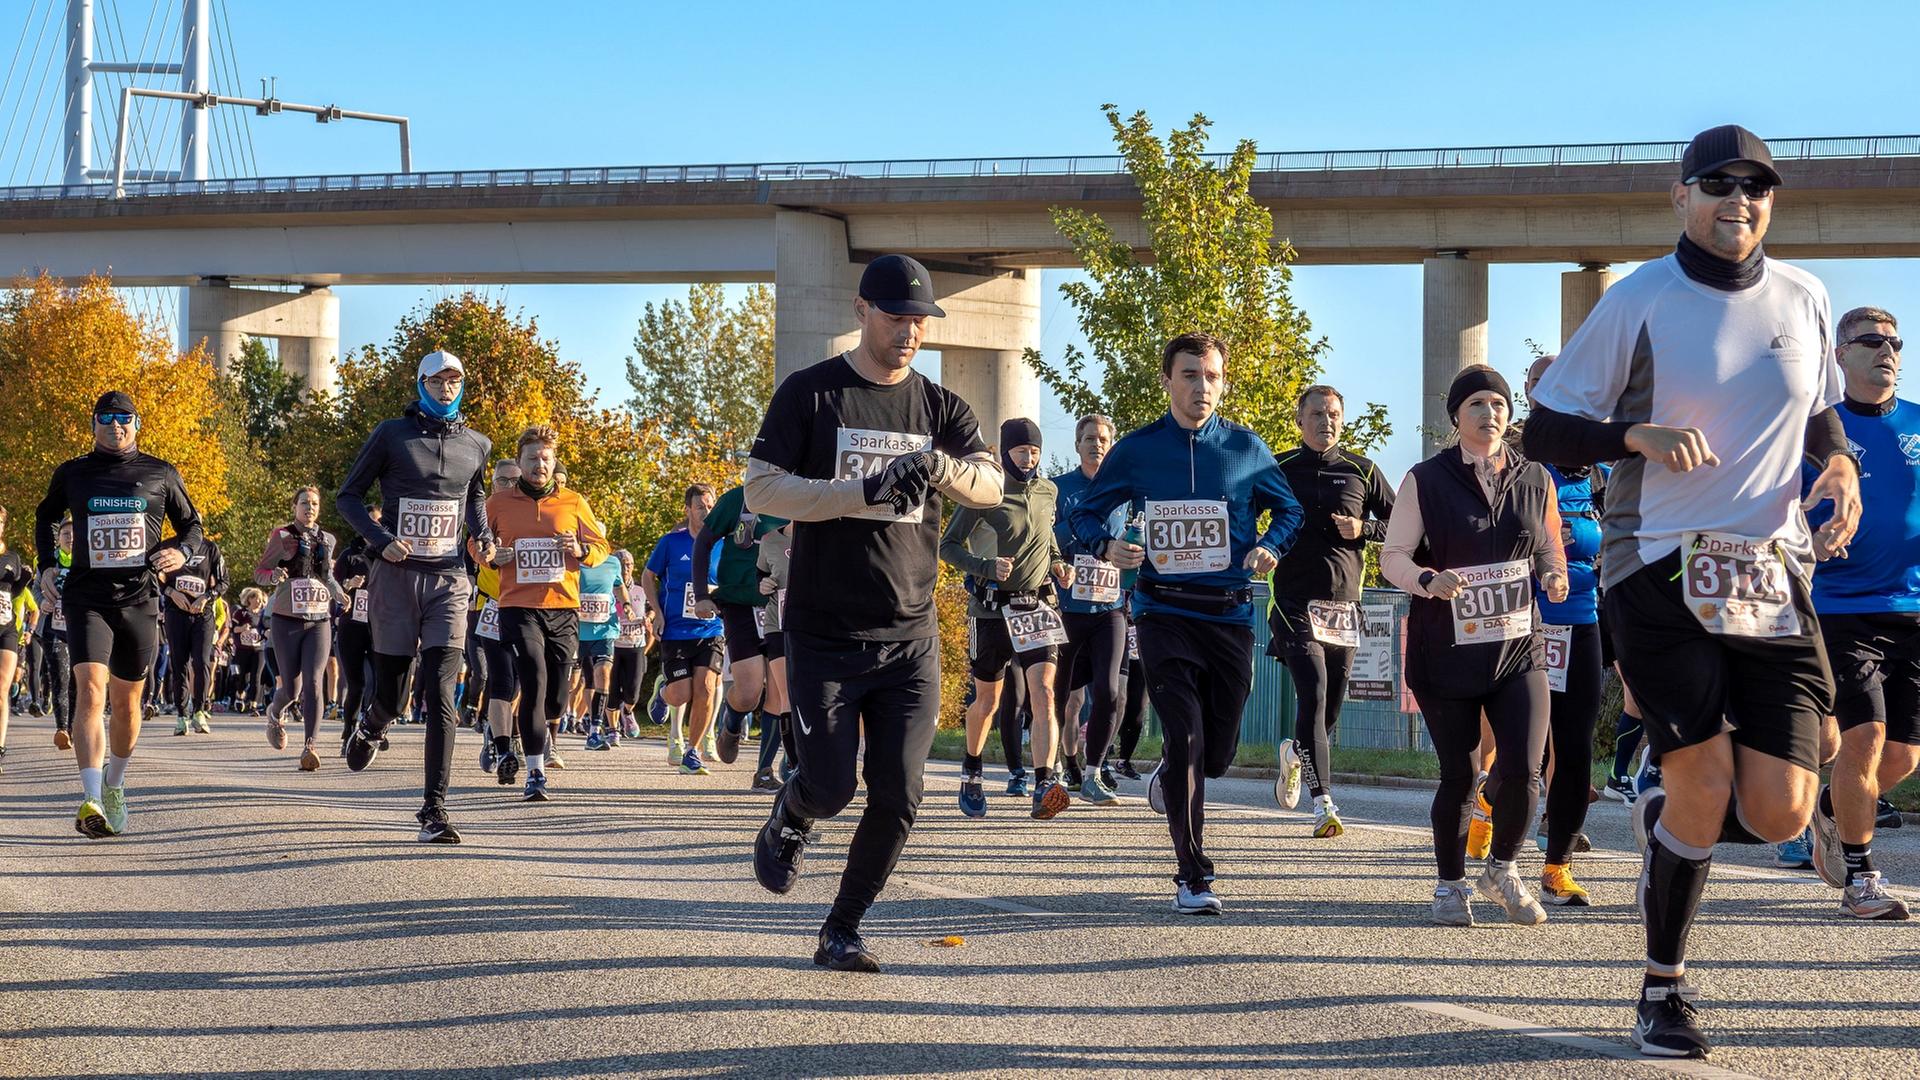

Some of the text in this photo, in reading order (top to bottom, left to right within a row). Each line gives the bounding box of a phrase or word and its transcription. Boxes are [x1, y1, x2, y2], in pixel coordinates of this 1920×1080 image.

[850, 433, 922, 452] Sparkasse
[94, 499, 141, 508] FINISHER
[408, 501, 454, 512] Sparkasse
[1154, 504, 1219, 518] Sparkasse
[95, 517, 141, 526] Sparkasse
[403, 514, 453, 537] 3087
[93, 530, 141, 549] 3155
[1153, 521, 1221, 549] 3043
[520, 541, 557, 550] Sparkass
[520, 551, 560, 568] 3020
[1174, 551, 1202, 560] DAK
[295, 588, 327, 601] 3176
[1461, 582, 1524, 618] 3017
[582, 602, 608, 613] 3537
[1011, 611, 1057, 635] 3374
[1483, 617, 1511, 629] DAK
[1302, 749, 1319, 788] UNDER
